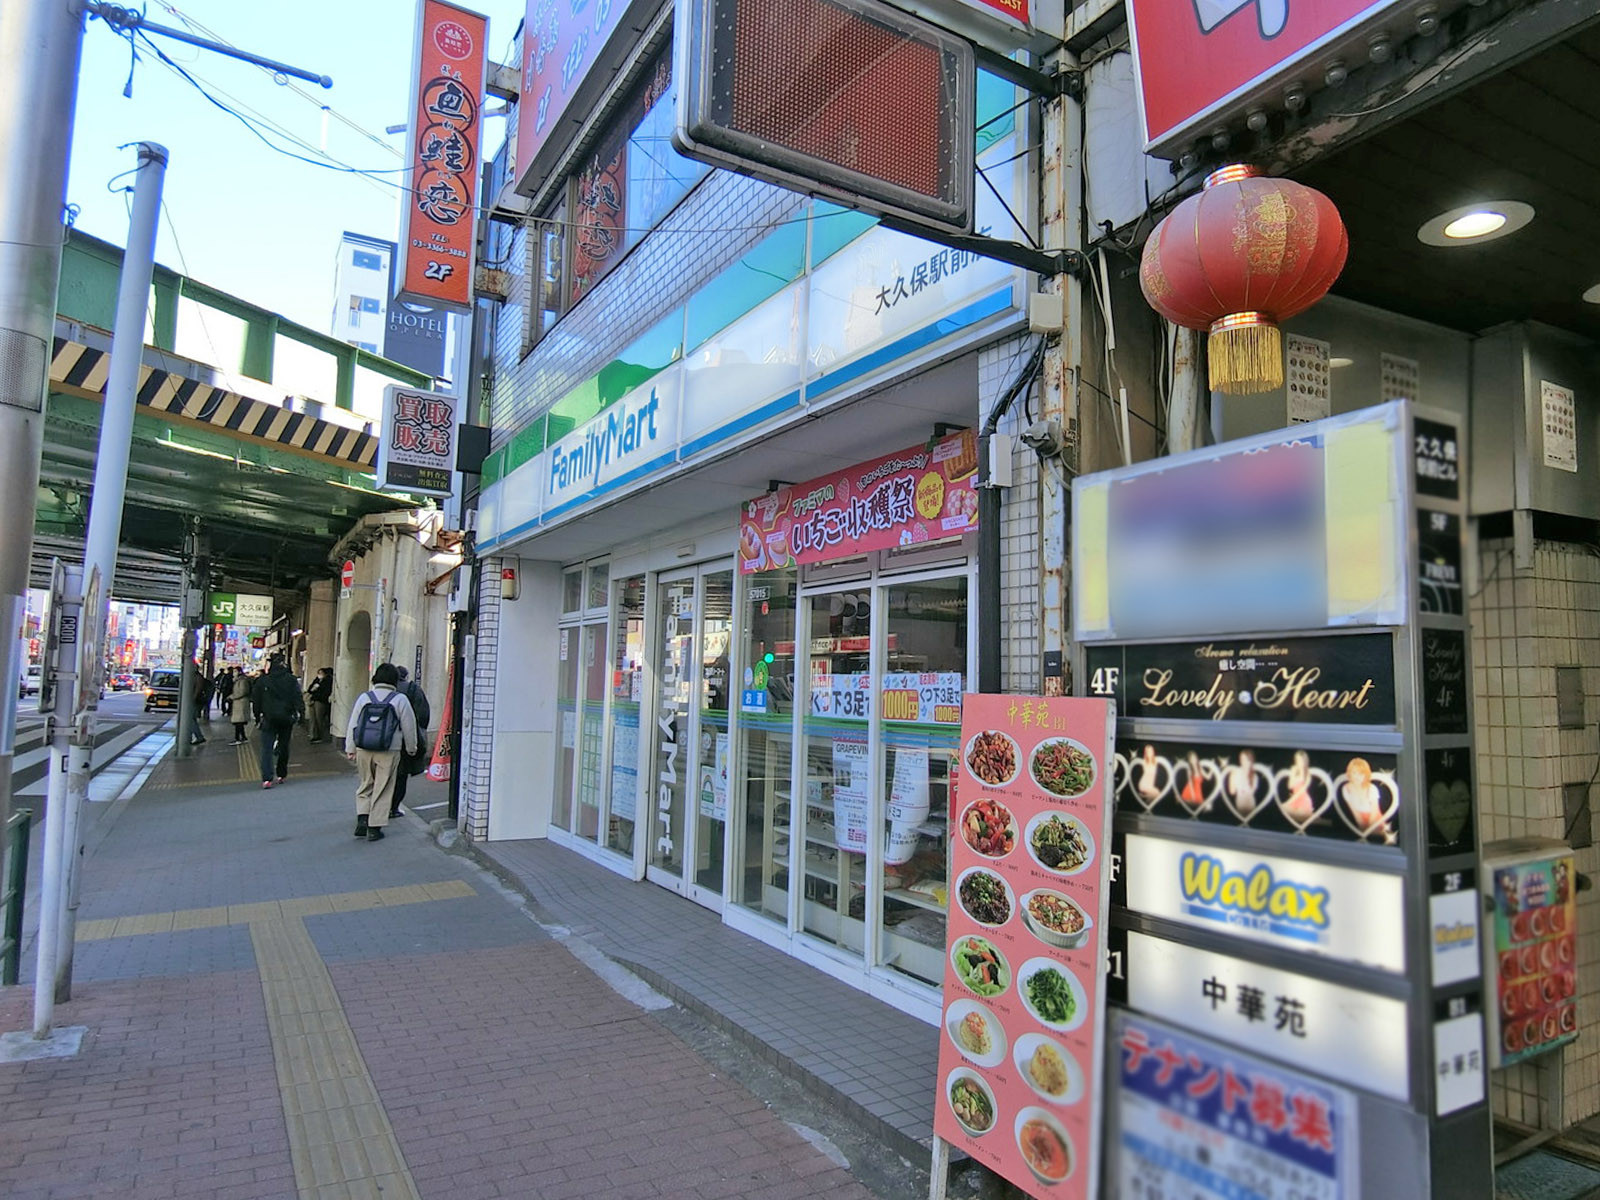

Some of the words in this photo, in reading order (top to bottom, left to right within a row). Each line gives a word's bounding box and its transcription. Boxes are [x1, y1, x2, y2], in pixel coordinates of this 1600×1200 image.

[424, 260, 454, 282] 2F
[390, 311, 445, 333] HOTEL
[397, 393, 452, 427] 買取
[392, 422, 450, 456] 販売
[550, 387, 659, 494] FamilyMart
[791, 474, 915, 554] いちご収穫祭
[793, 484, 834, 517] ファミマの
[212, 601, 234, 614] JR
[920, 687, 960, 704] くつ下3足で
[1091, 667, 1119, 695] 4F
[1139, 667, 1236, 721] Lovely
[1253, 666, 1375, 710] Heart
[812, 690, 869, 717] く下3足
[657, 586, 684, 856] FamilyMart
[835, 743, 868, 756] GRAPEVIN
[1110, 855, 1122, 882] F
[1444, 872, 1461, 891] 2F
[1181, 853, 1329, 928] Walax
[1202, 976, 1307, 1038] 中華苑
[1121, 1027, 1334, 1155] テナント募集
